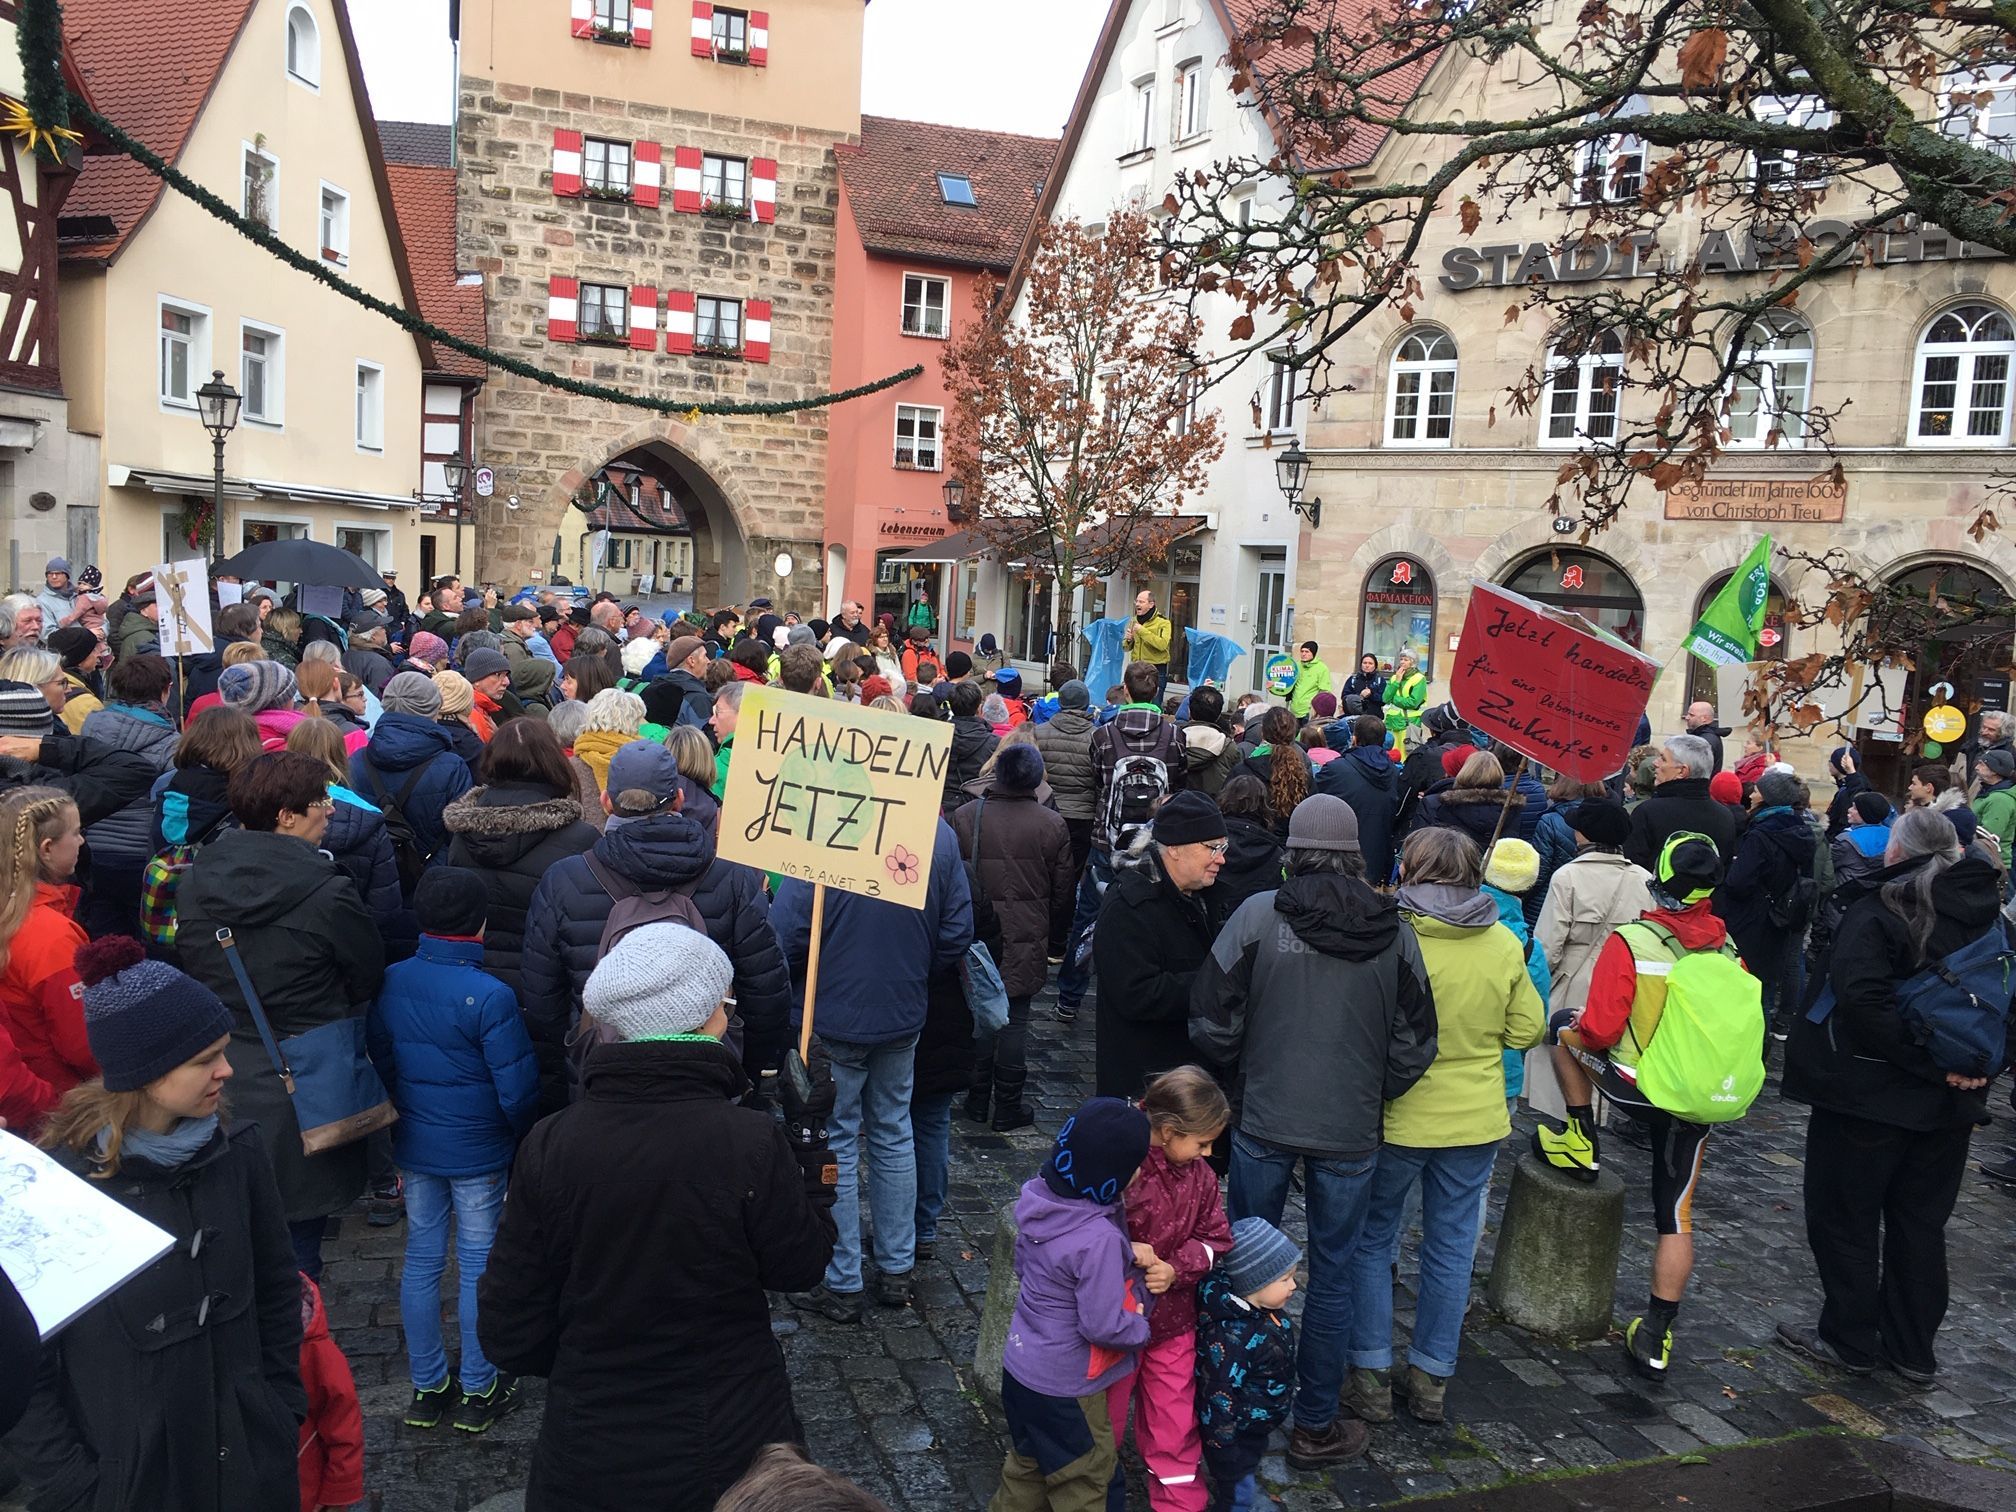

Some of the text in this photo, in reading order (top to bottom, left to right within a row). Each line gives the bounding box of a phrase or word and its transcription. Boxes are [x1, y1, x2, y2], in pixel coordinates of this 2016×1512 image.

[1437, 234, 1655, 290] STADT
[1749, 483, 1766, 497] im
[1767, 480, 1804, 501] Jahre
[1686, 502, 1823, 521] von Christoph Treu
[880, 522, 945, 536] Lebensraum
[1556, 520, 1571, 531] 31
[1487, 607, 1556, 647] Jetzt
[1708, 630, 1725, 644] Wir
[1511, 678, 1538, 694] eine
[757, 709, 950, 781] HANDELN
[744, 769, 906, 855] JETZT
[780, 861, 797, 875] NO
[802, 865, 857, 889] PLANET
